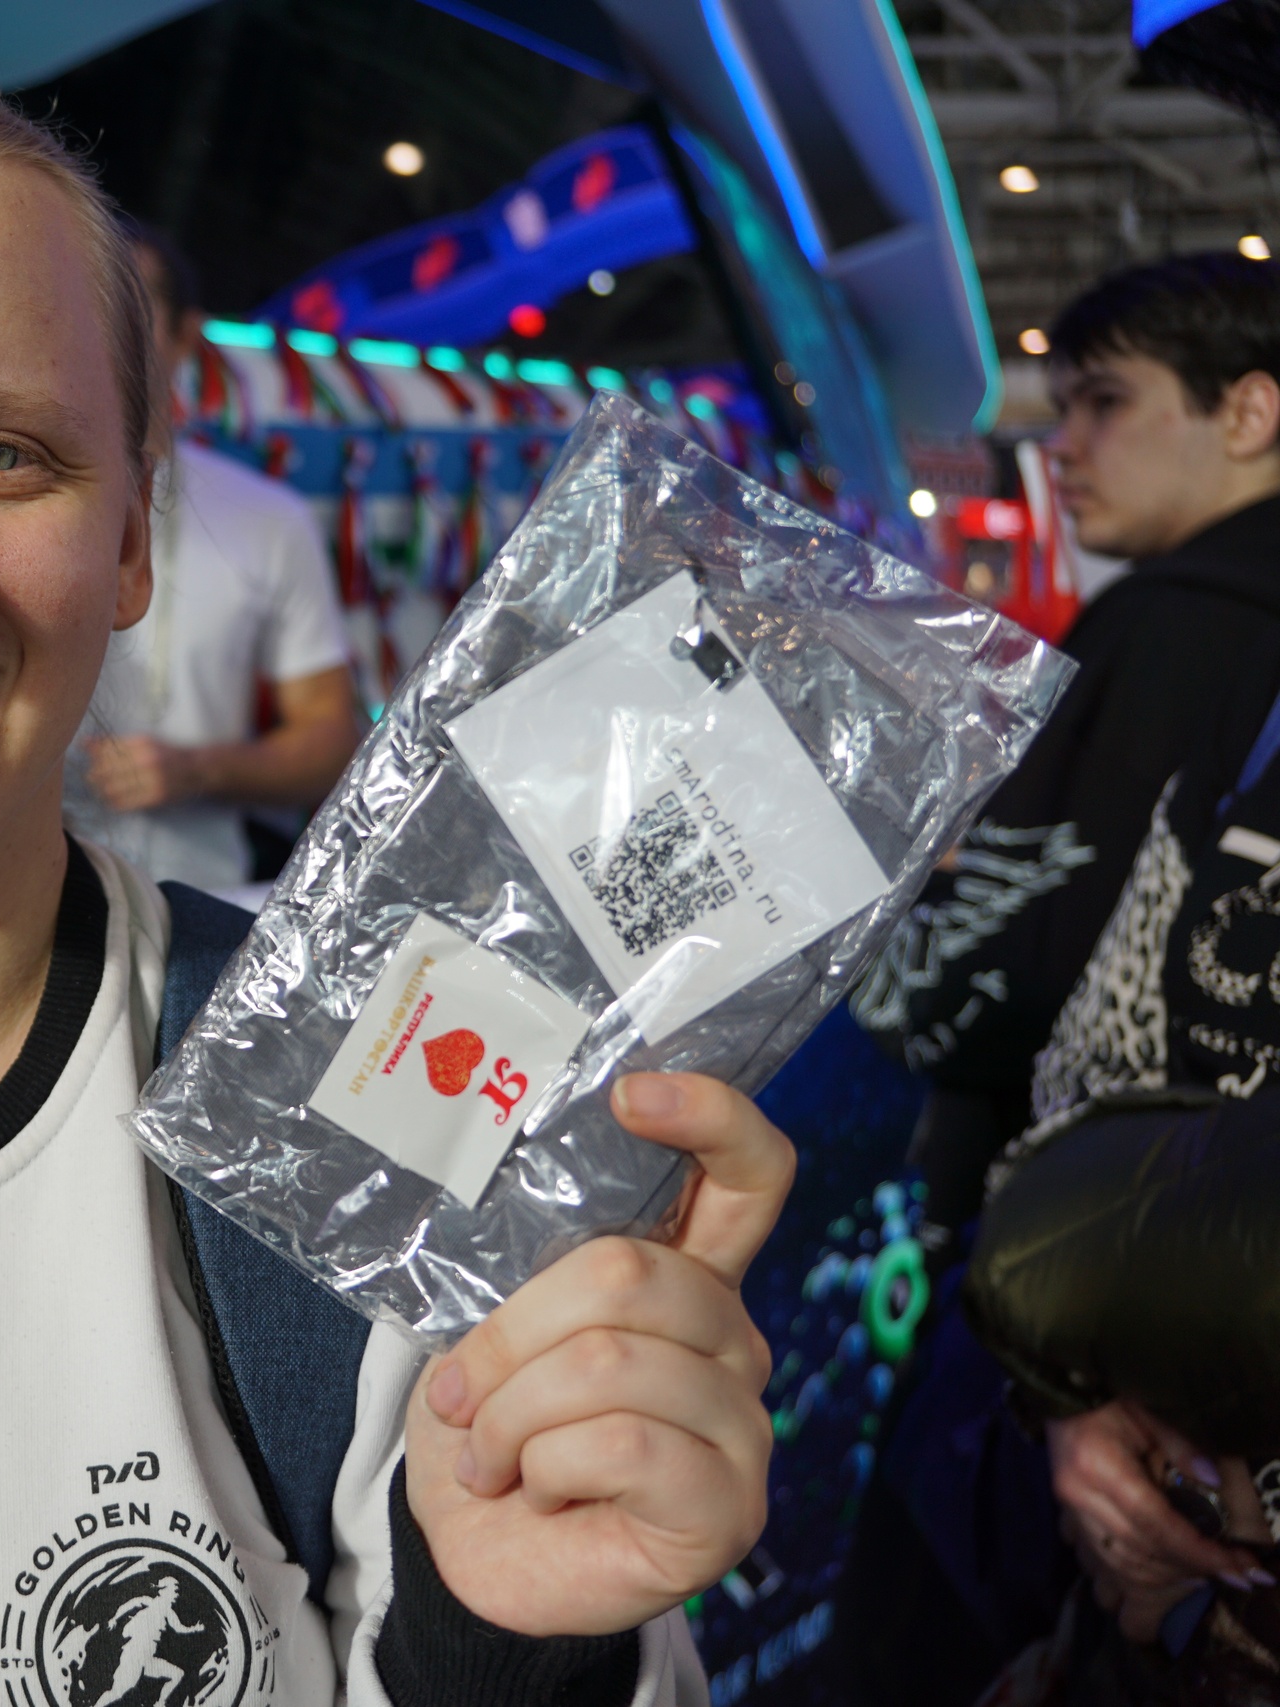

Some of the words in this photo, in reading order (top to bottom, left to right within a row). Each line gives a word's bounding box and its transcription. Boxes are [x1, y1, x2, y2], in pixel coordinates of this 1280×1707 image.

[381, 991, 435, 1075] РЕСПУБЛИКА
[477, 1056, 528, 1126] Я
[14, 1502, 151, 1596] GOLDEN
